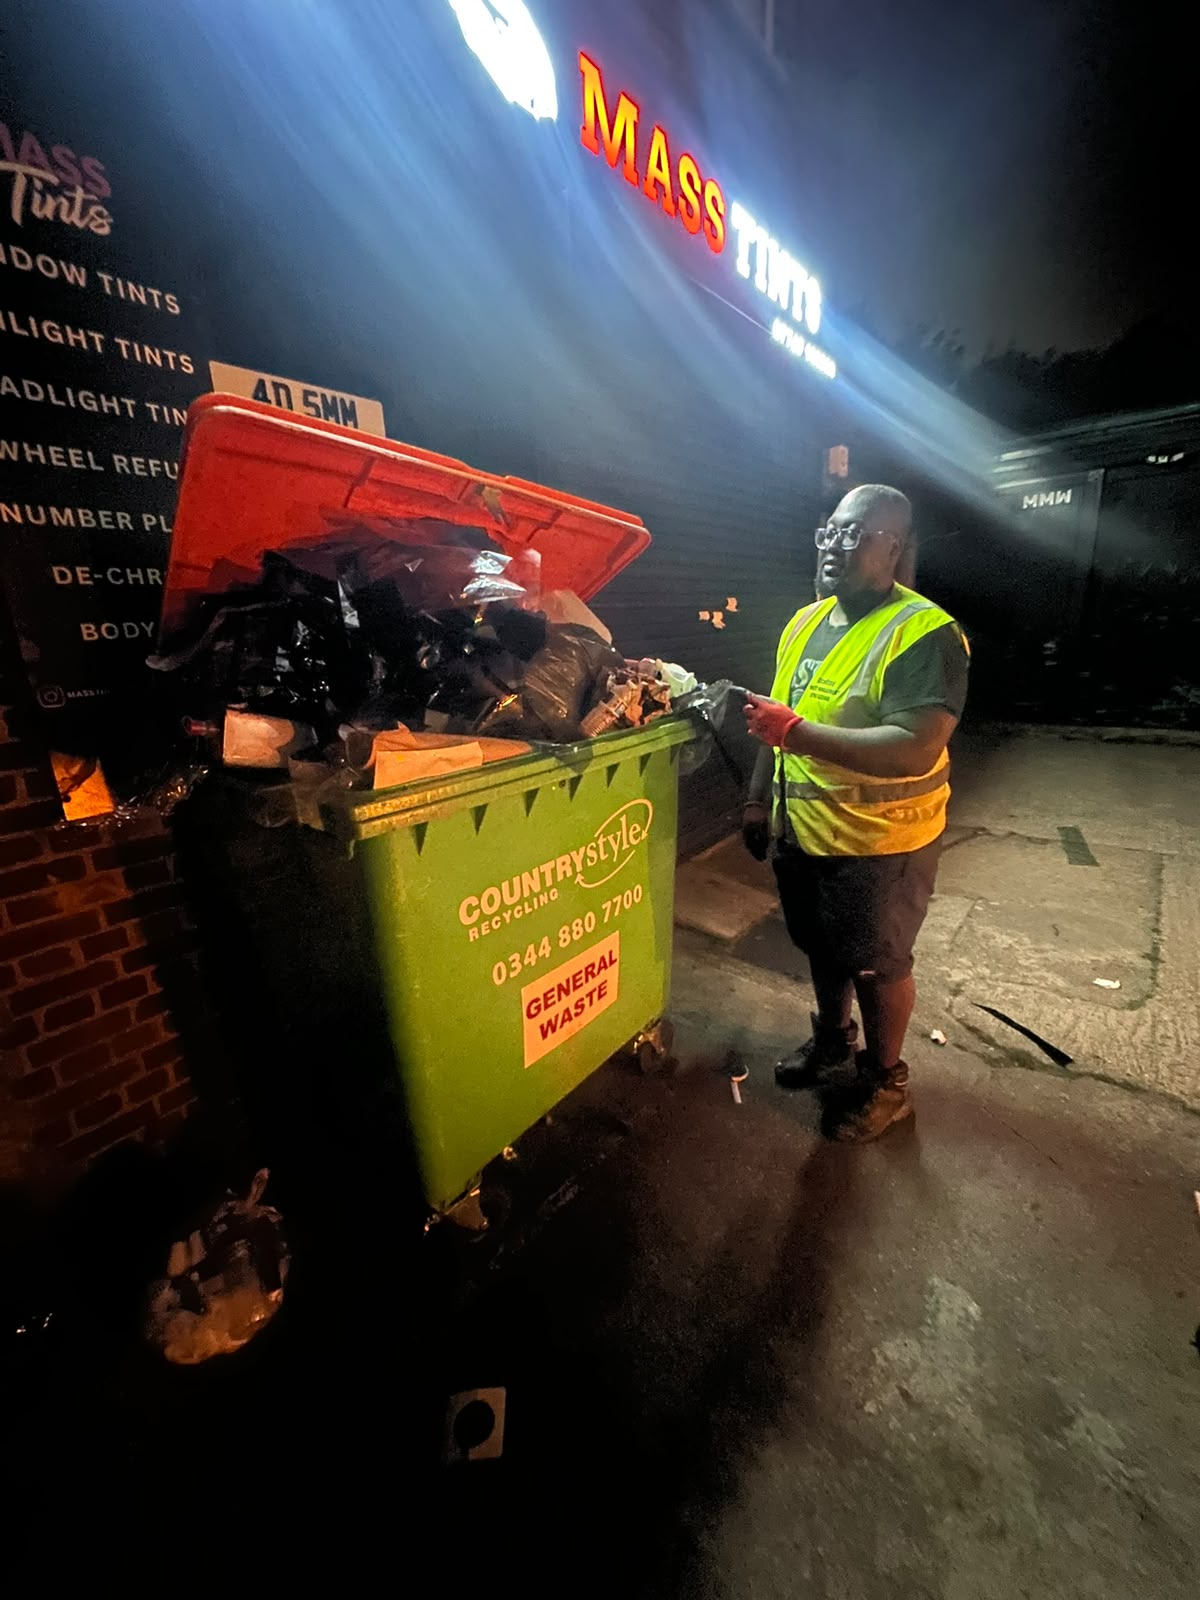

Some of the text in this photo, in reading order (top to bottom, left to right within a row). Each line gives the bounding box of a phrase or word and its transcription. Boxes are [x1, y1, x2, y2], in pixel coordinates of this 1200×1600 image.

[579, 50, 726, 254] MASS
[0, 161, 114, 236] Tints
[97, 271, 181, 315] TINTS
[114, 337, 195, 374] TINTS
[252, 378, 359, 429] 4D 5MM
[0, 502, 172, 532] NUMBER PL
[1022, 489, 1072, 509] MMW
[80, 621, 154, 641] BODY
[468, 888, 560, 942] RECYCLING
[492, 884, 643, 986] 0344 880 7700
[525, 949, 618, 1020] GENERAL
[539, 980, 608, 1041] WASTE
